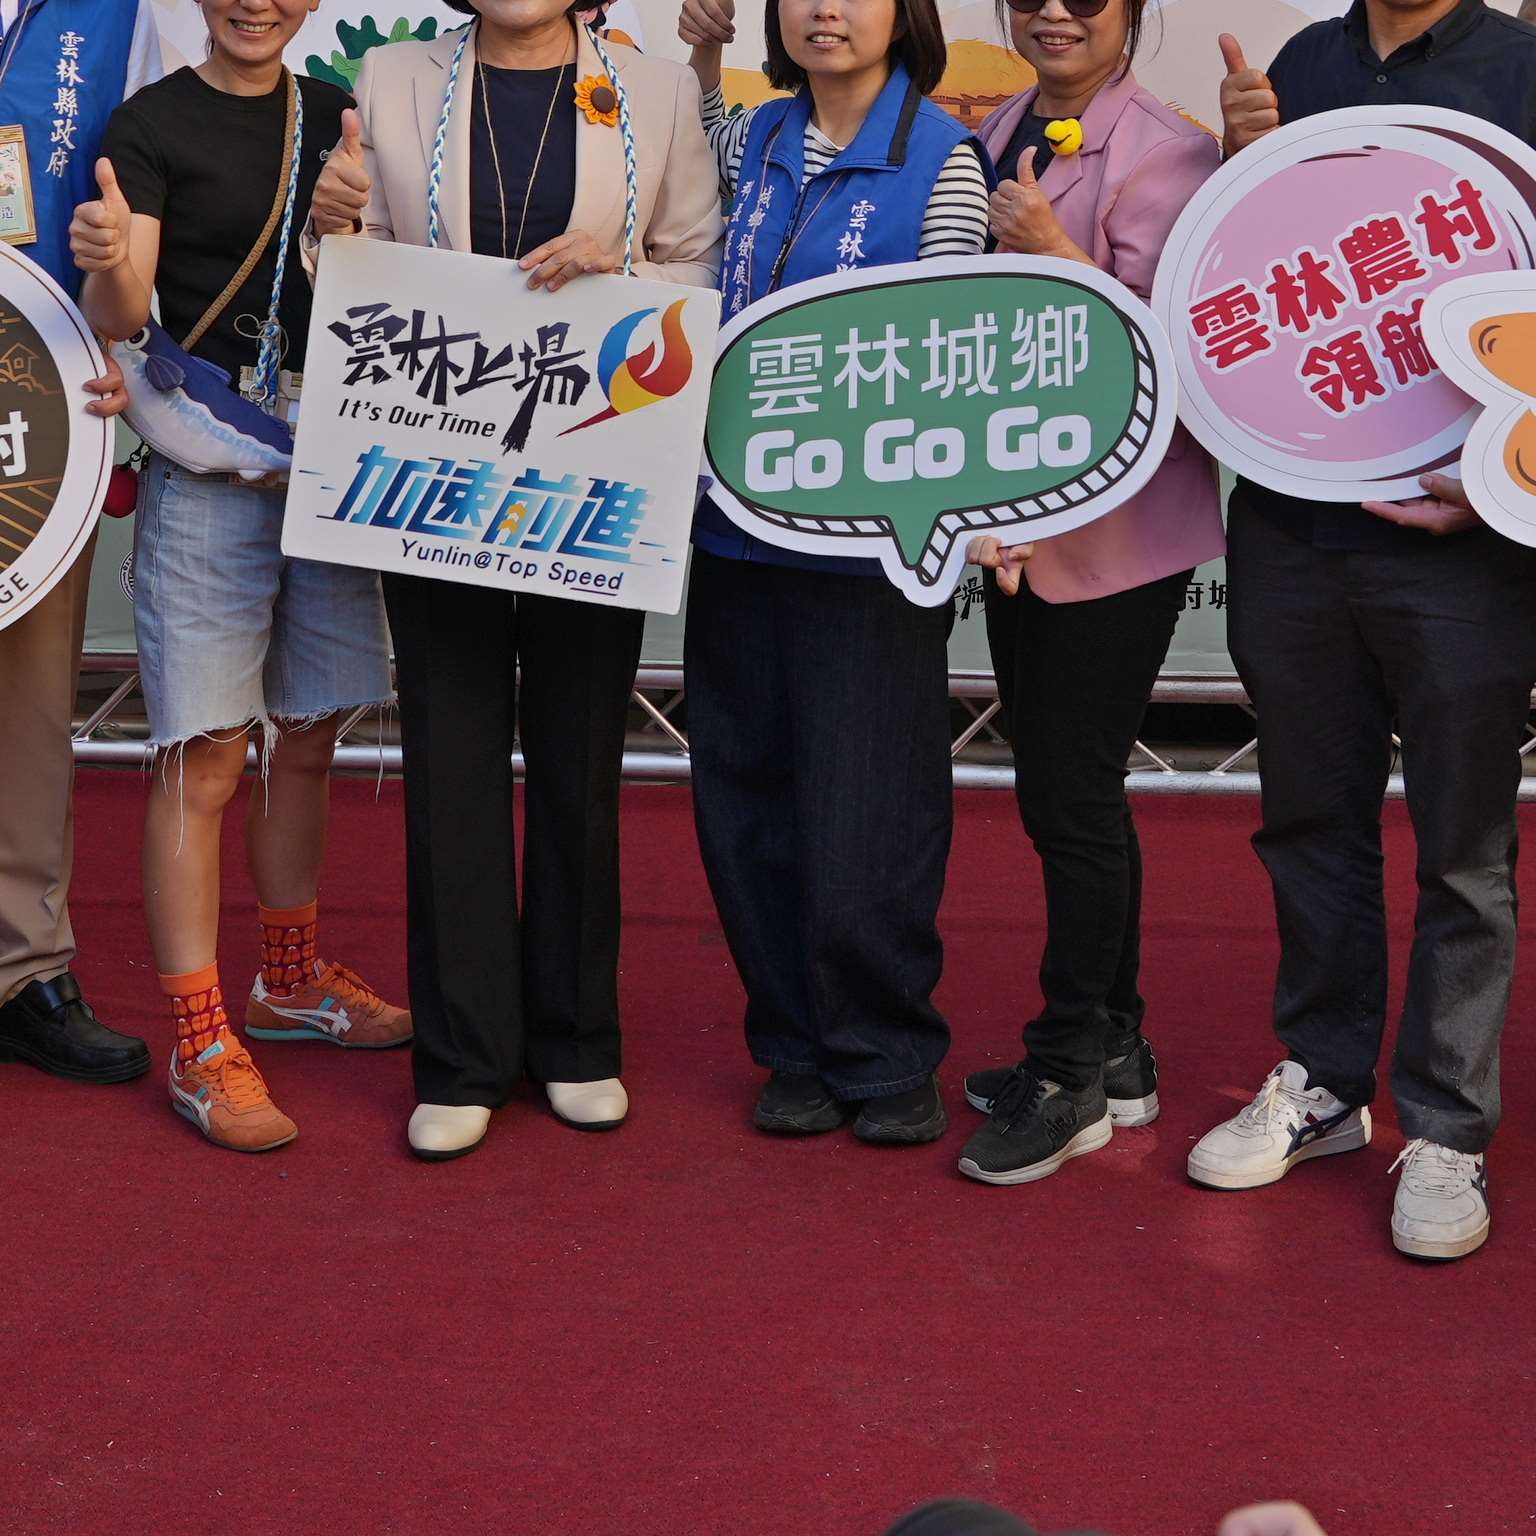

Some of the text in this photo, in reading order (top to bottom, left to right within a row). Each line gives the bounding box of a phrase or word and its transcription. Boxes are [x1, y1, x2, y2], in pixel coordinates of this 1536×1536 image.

[45, 30, 86, 178] 雲林縣政府
[1188, 179, 1497, 370] 雲林農村
[327, 302, 591, 455] 雲林上場
[749, 303, 1090, 418] 雲林城鄉
[388, 405, 435, 432] Our
[440, 412, 497, 439] Time
[328, 444, 658, 565] 加速前進
[400, 538, 624, 591] Yunlin@Top Speed
